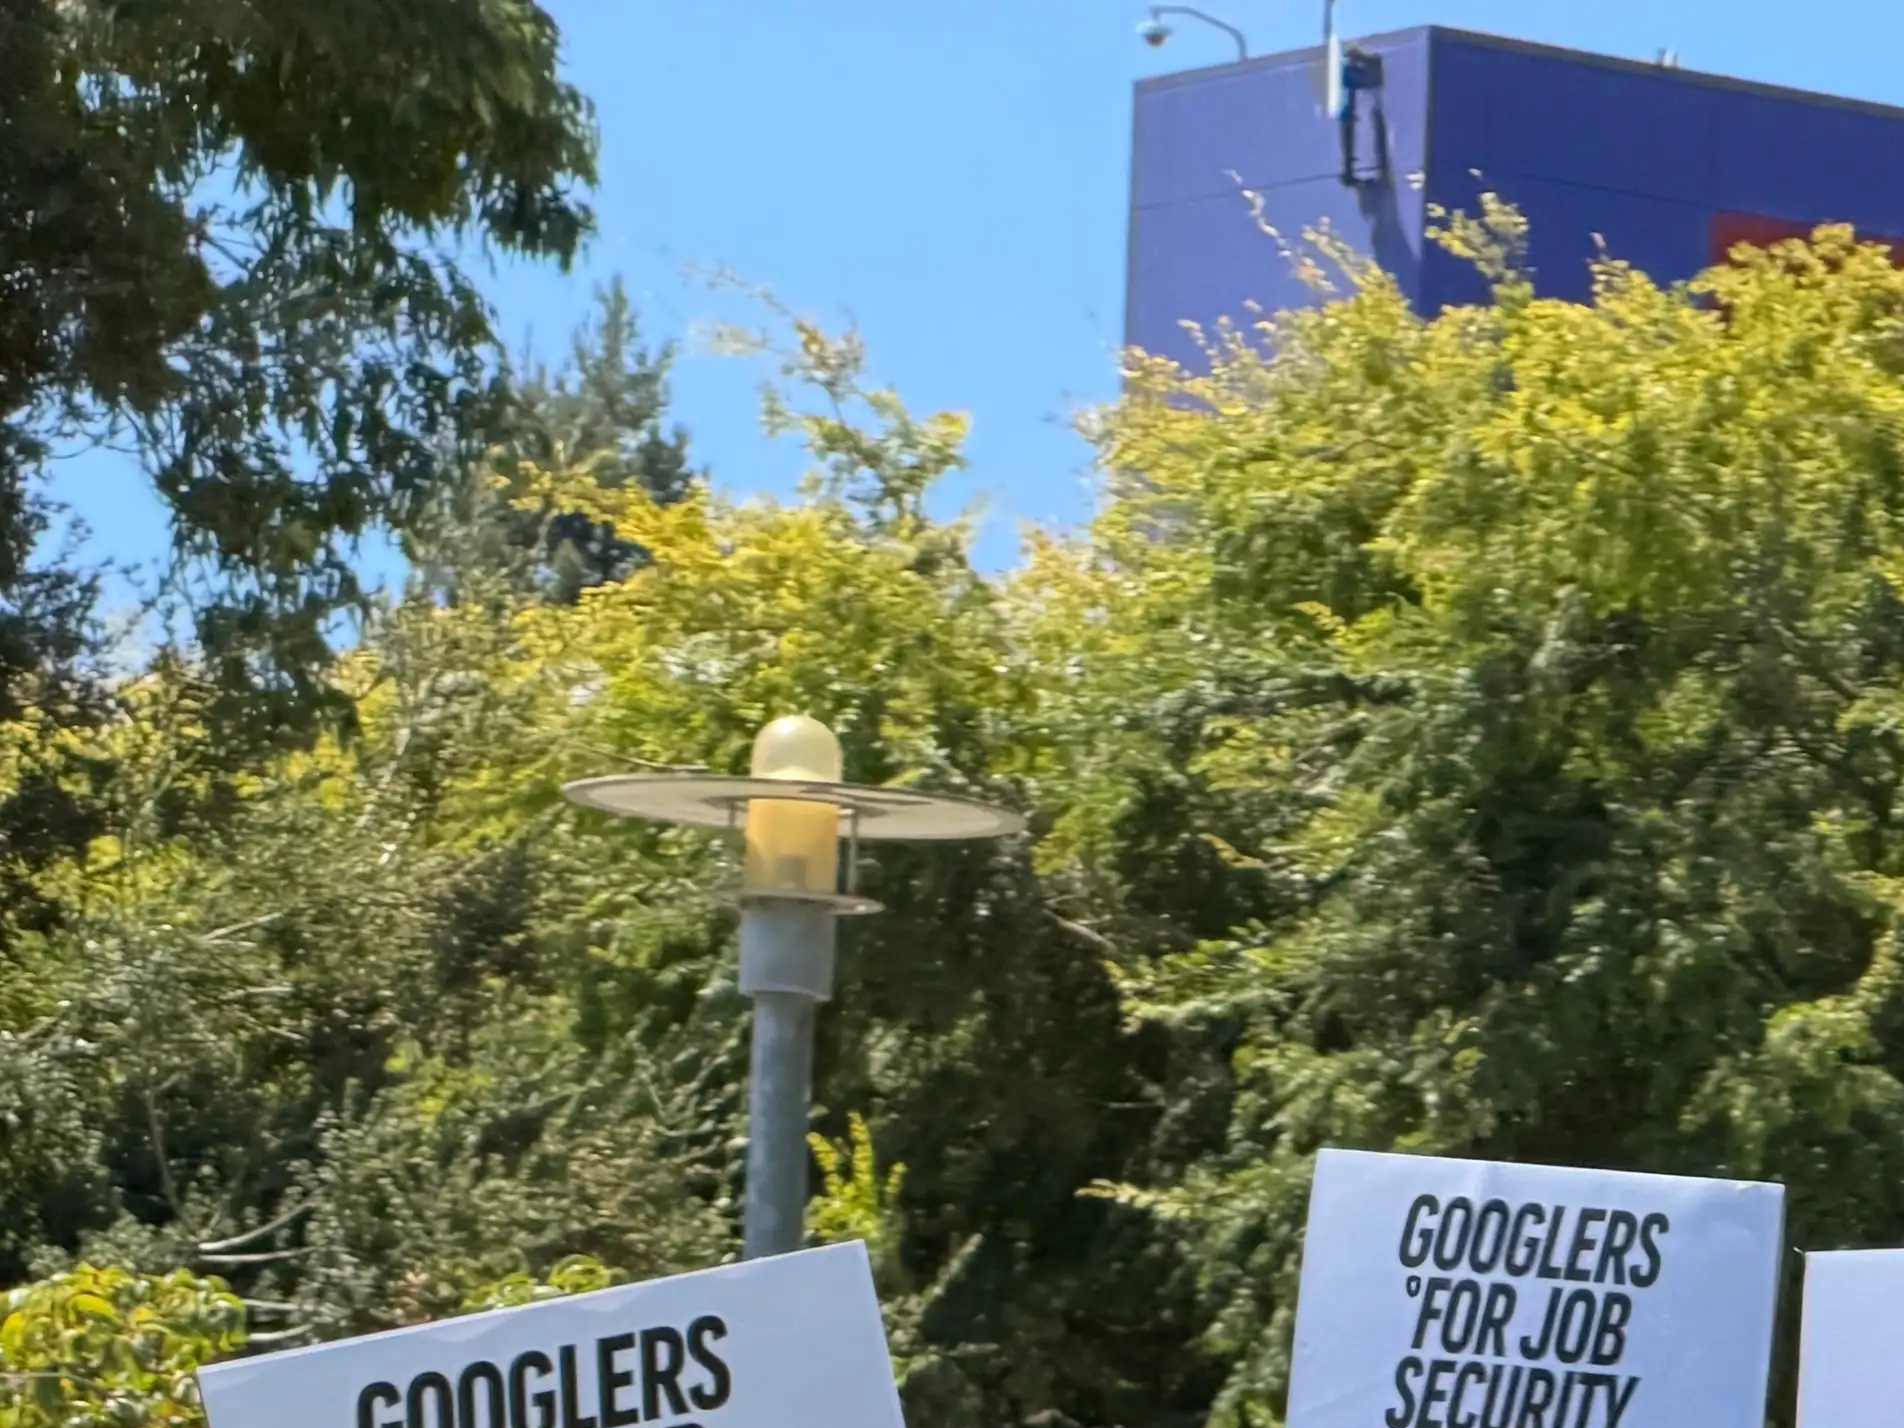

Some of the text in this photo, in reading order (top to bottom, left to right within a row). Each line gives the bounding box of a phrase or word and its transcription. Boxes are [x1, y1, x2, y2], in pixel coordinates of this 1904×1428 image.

[1400, 1193, 1668, 1288] GOOGLERS
[1412, 1278, 1631, 1367] FOR JOB
